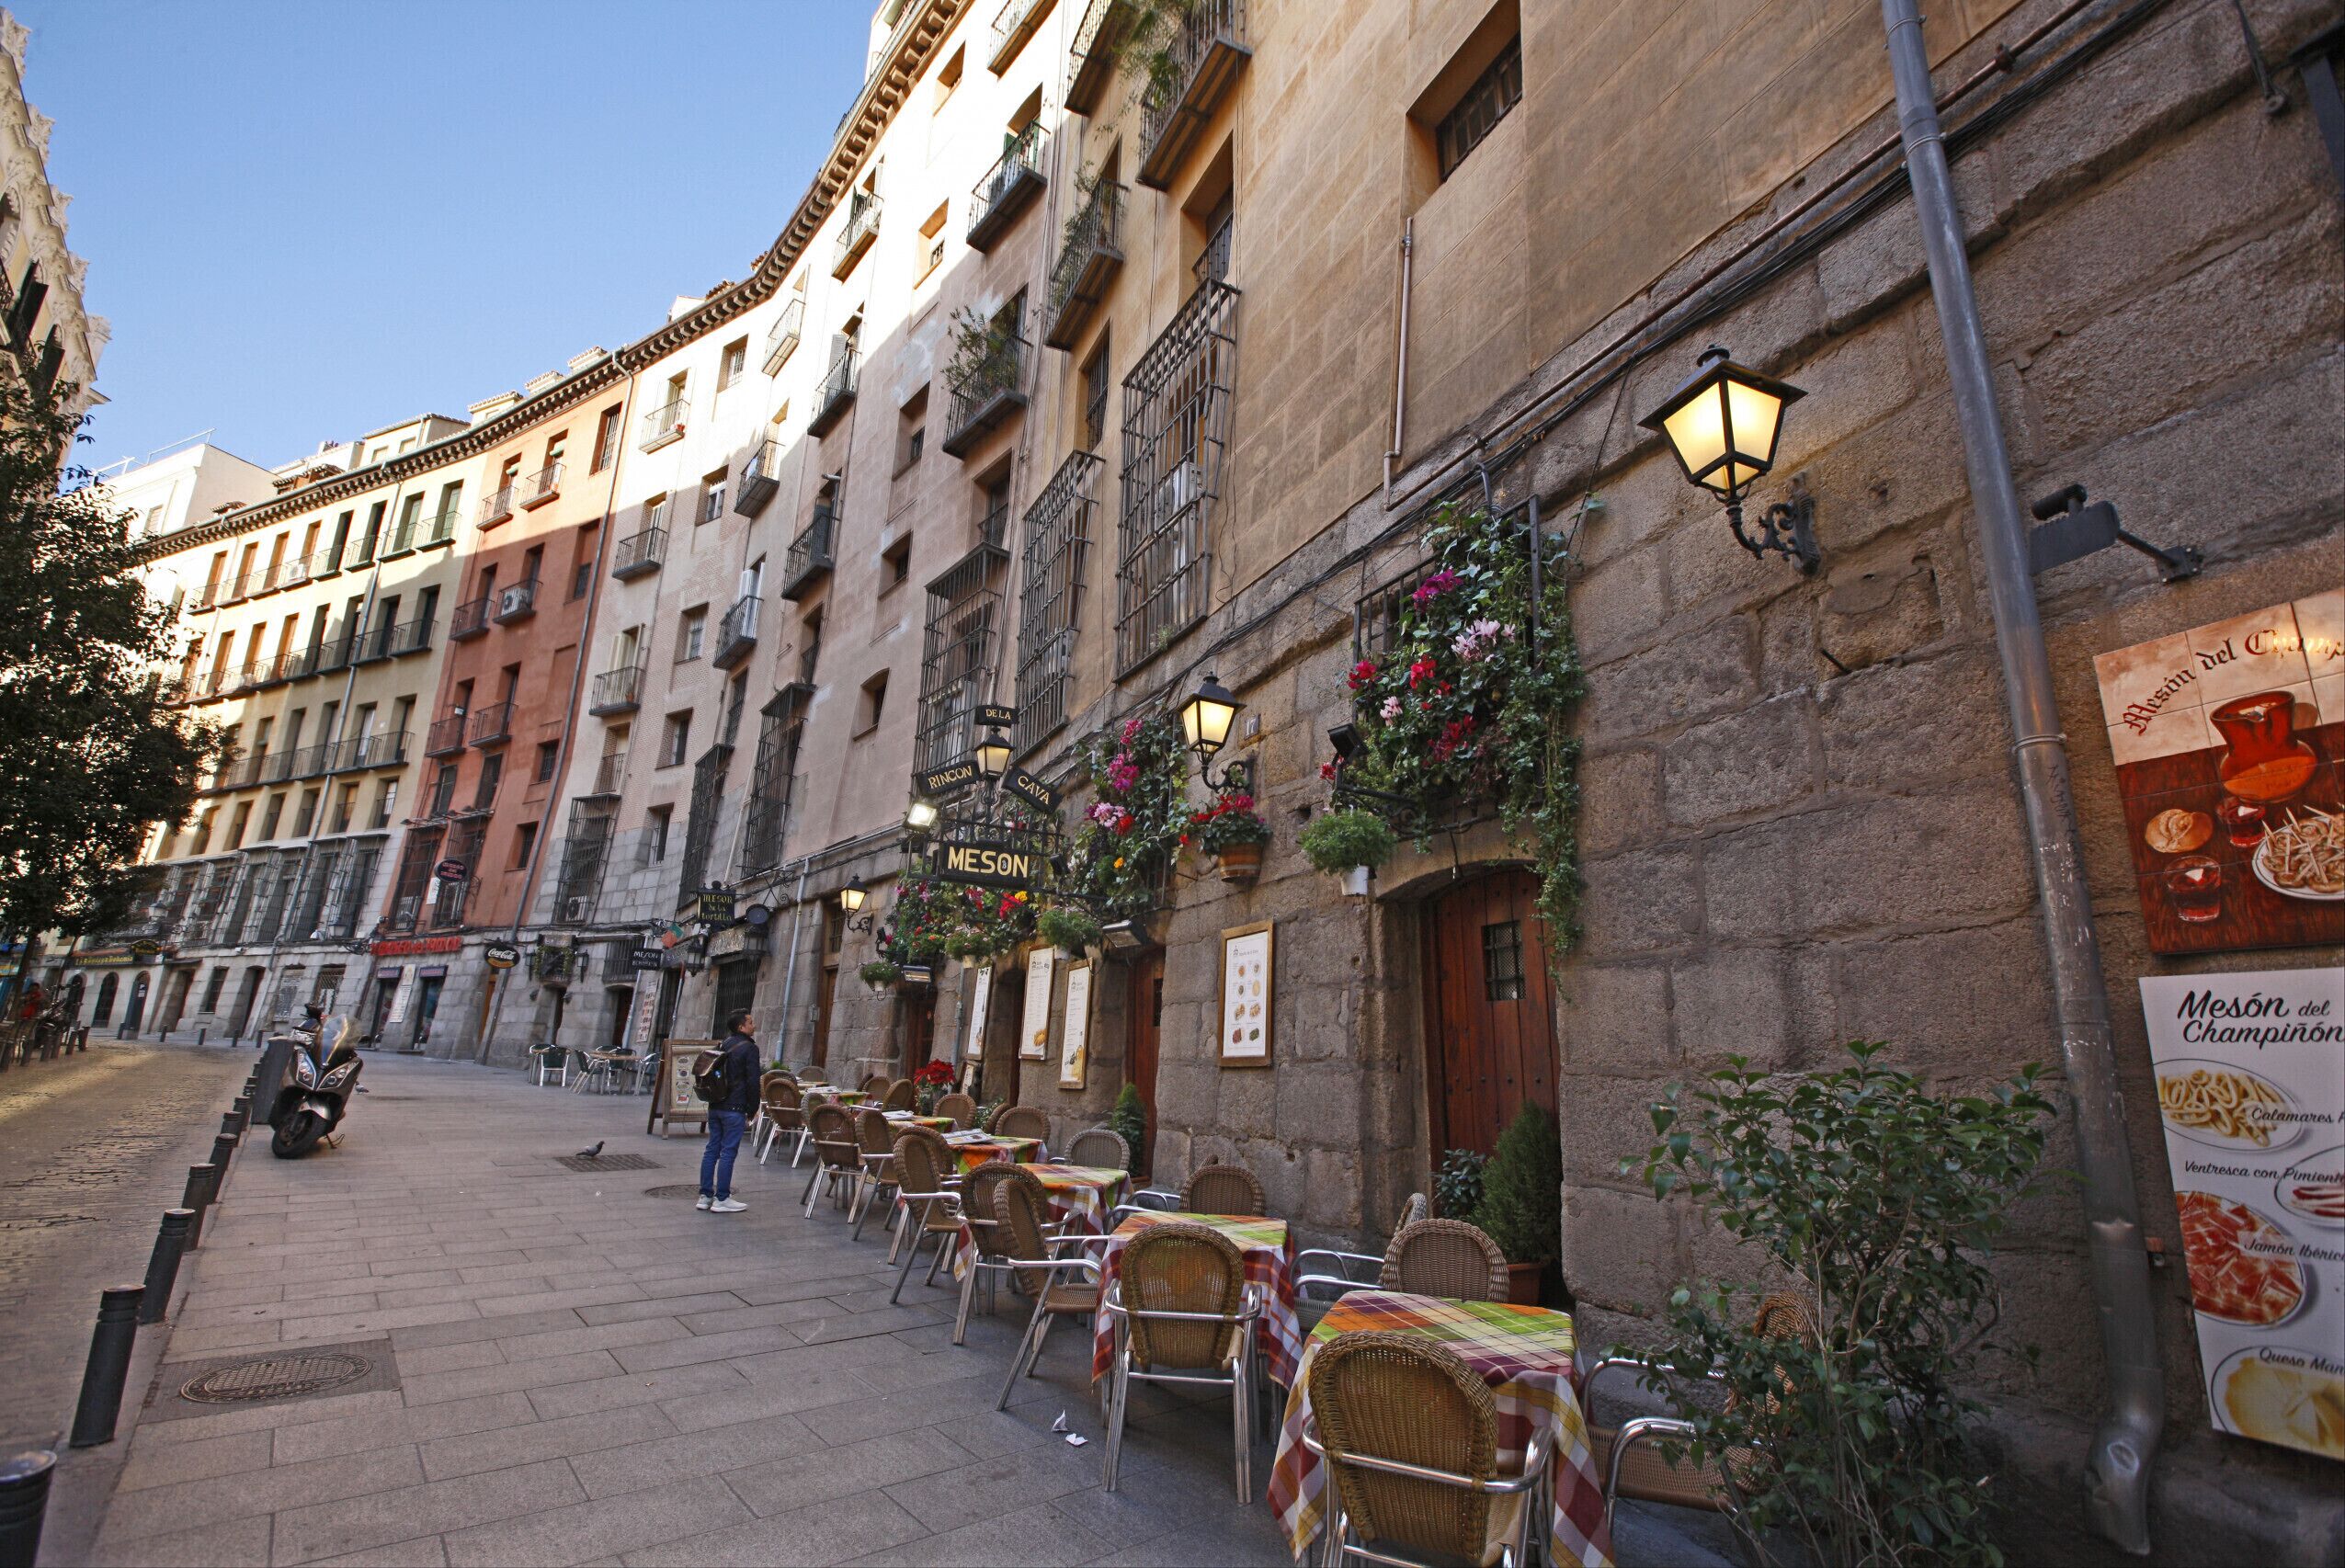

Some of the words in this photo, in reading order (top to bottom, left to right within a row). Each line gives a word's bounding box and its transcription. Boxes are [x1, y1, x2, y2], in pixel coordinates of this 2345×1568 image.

[2122, 668, 2196, 735] Mesón
[2195, 637, 2237, 671] del
[985, 709, 998, 719] DE
[998, 710, 1011, 721] LA
[928, 765, 973, 789] RINCON
[1018, 776, 1051, 805] CAVA
[947, 846, 1029, 878] MESON
[2177, 990, 2289, 1019] Mesón
[2298, 1000, 2330, 1017] del
[2182, 1019, 2343, 1050] Champiñón
[2251, 1108, 2334, 1124] Calamares
[2185, 1160, 2249, 1177] Ventresca
[2253, 1169, 2279, 1180] con
[2244, 1239, 2294, 1256] Jamón
[2260, 1346, 2305, 1368] Queso
